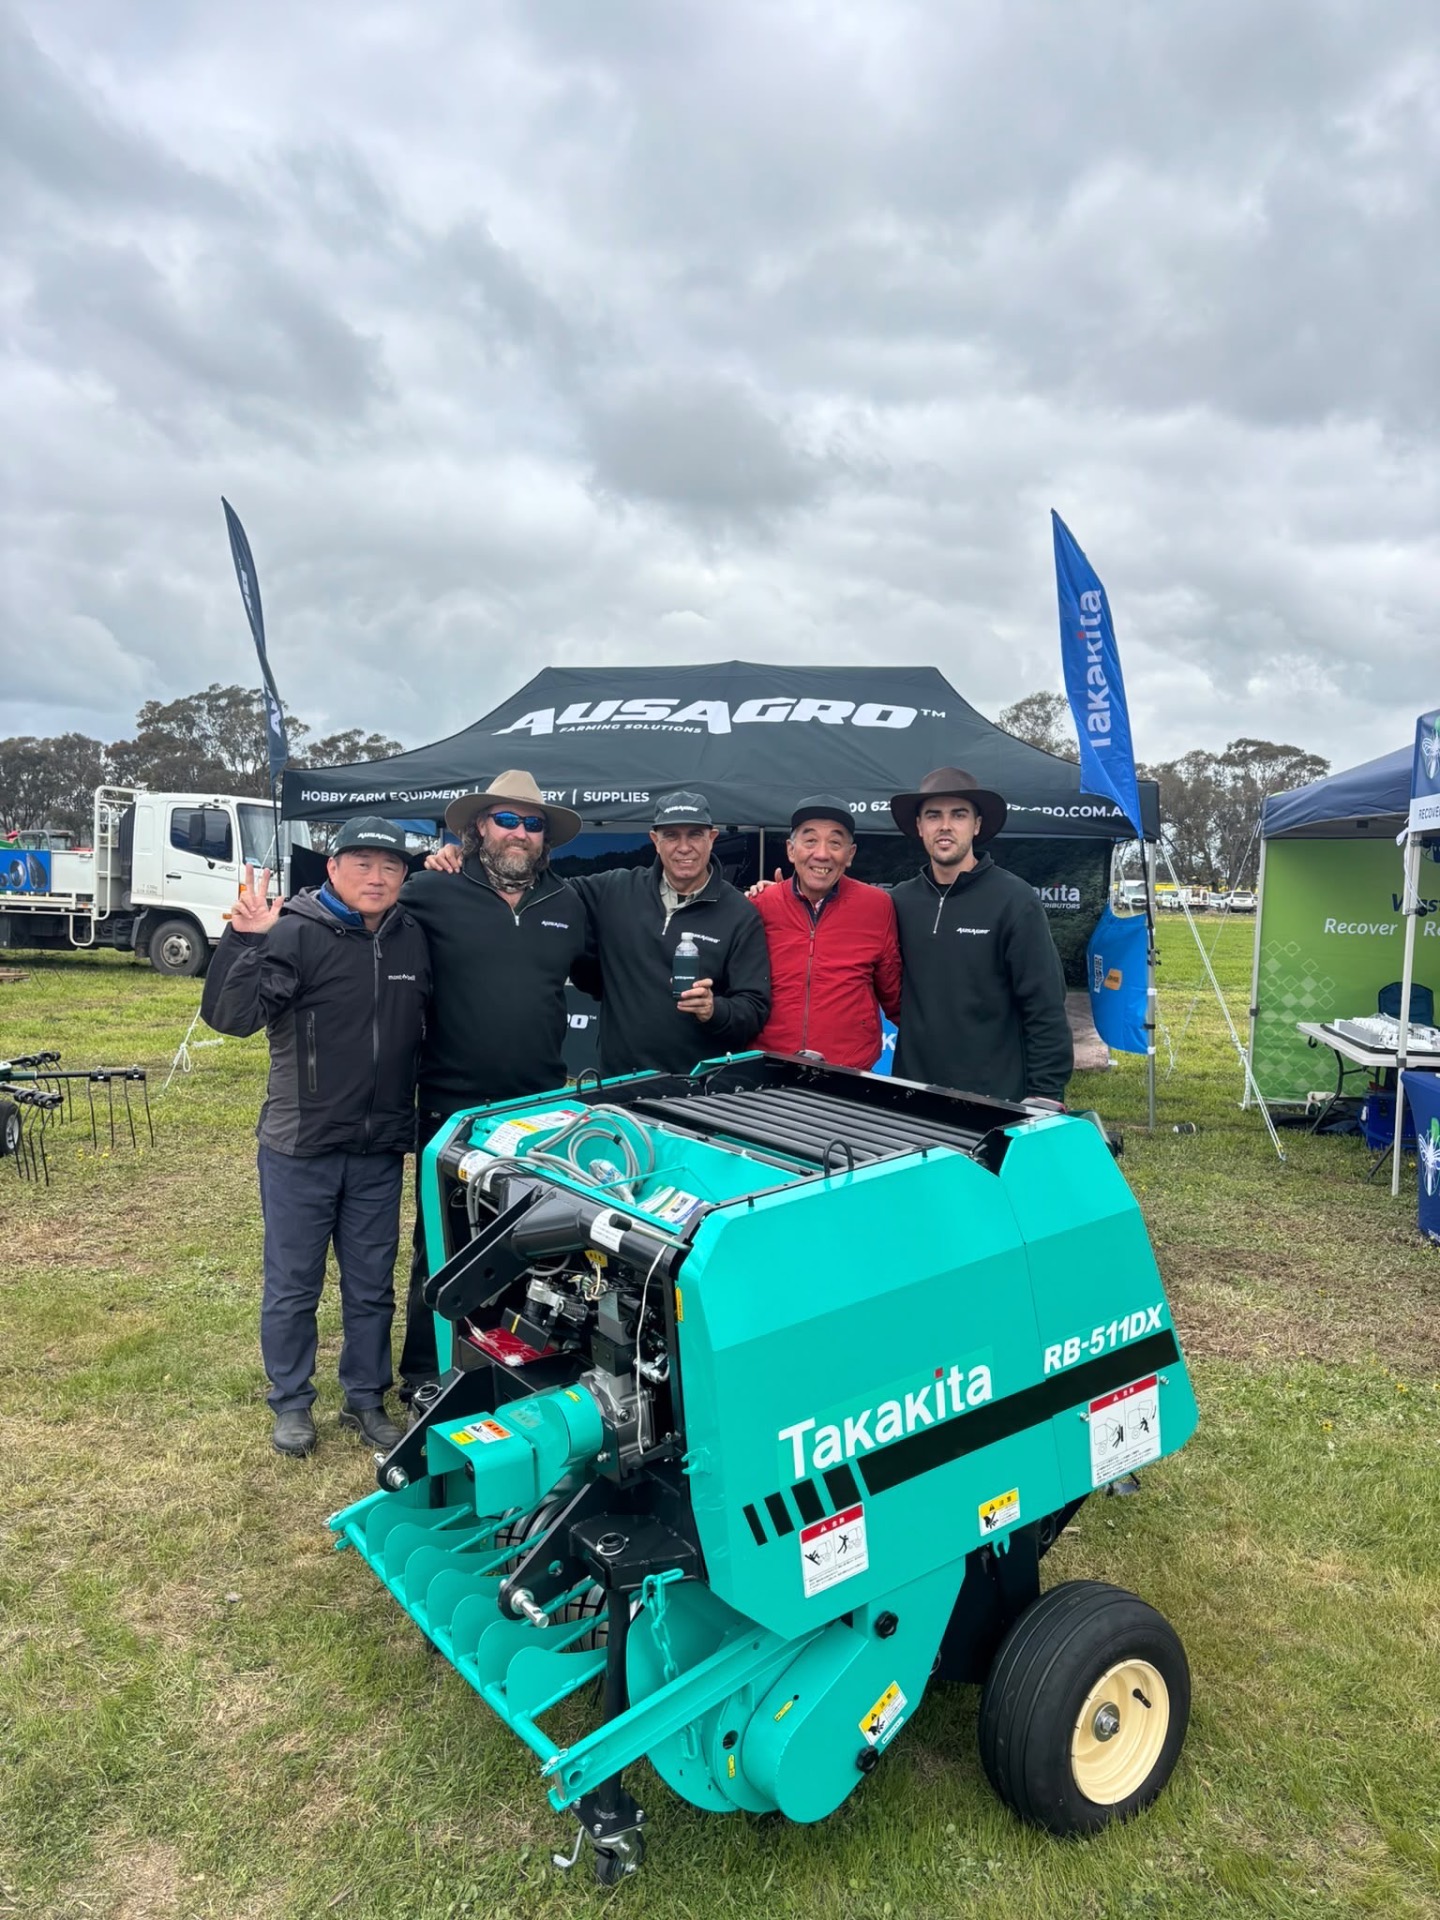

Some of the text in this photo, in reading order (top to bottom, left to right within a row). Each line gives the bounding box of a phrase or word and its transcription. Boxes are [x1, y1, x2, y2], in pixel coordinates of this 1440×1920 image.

[558, 723, 703, 734] FARMING SOLUTIONS
[301, 789, 469, 802] HOBBY FARM EQUIPMENT
[583, 791, 650, 803] SUPPLIES
[1324, 917, 1398, 936] Recover
[1043, 1302, 1164, 1374] RB-511DX
[778, 1364, 993, 1480] Takakita
